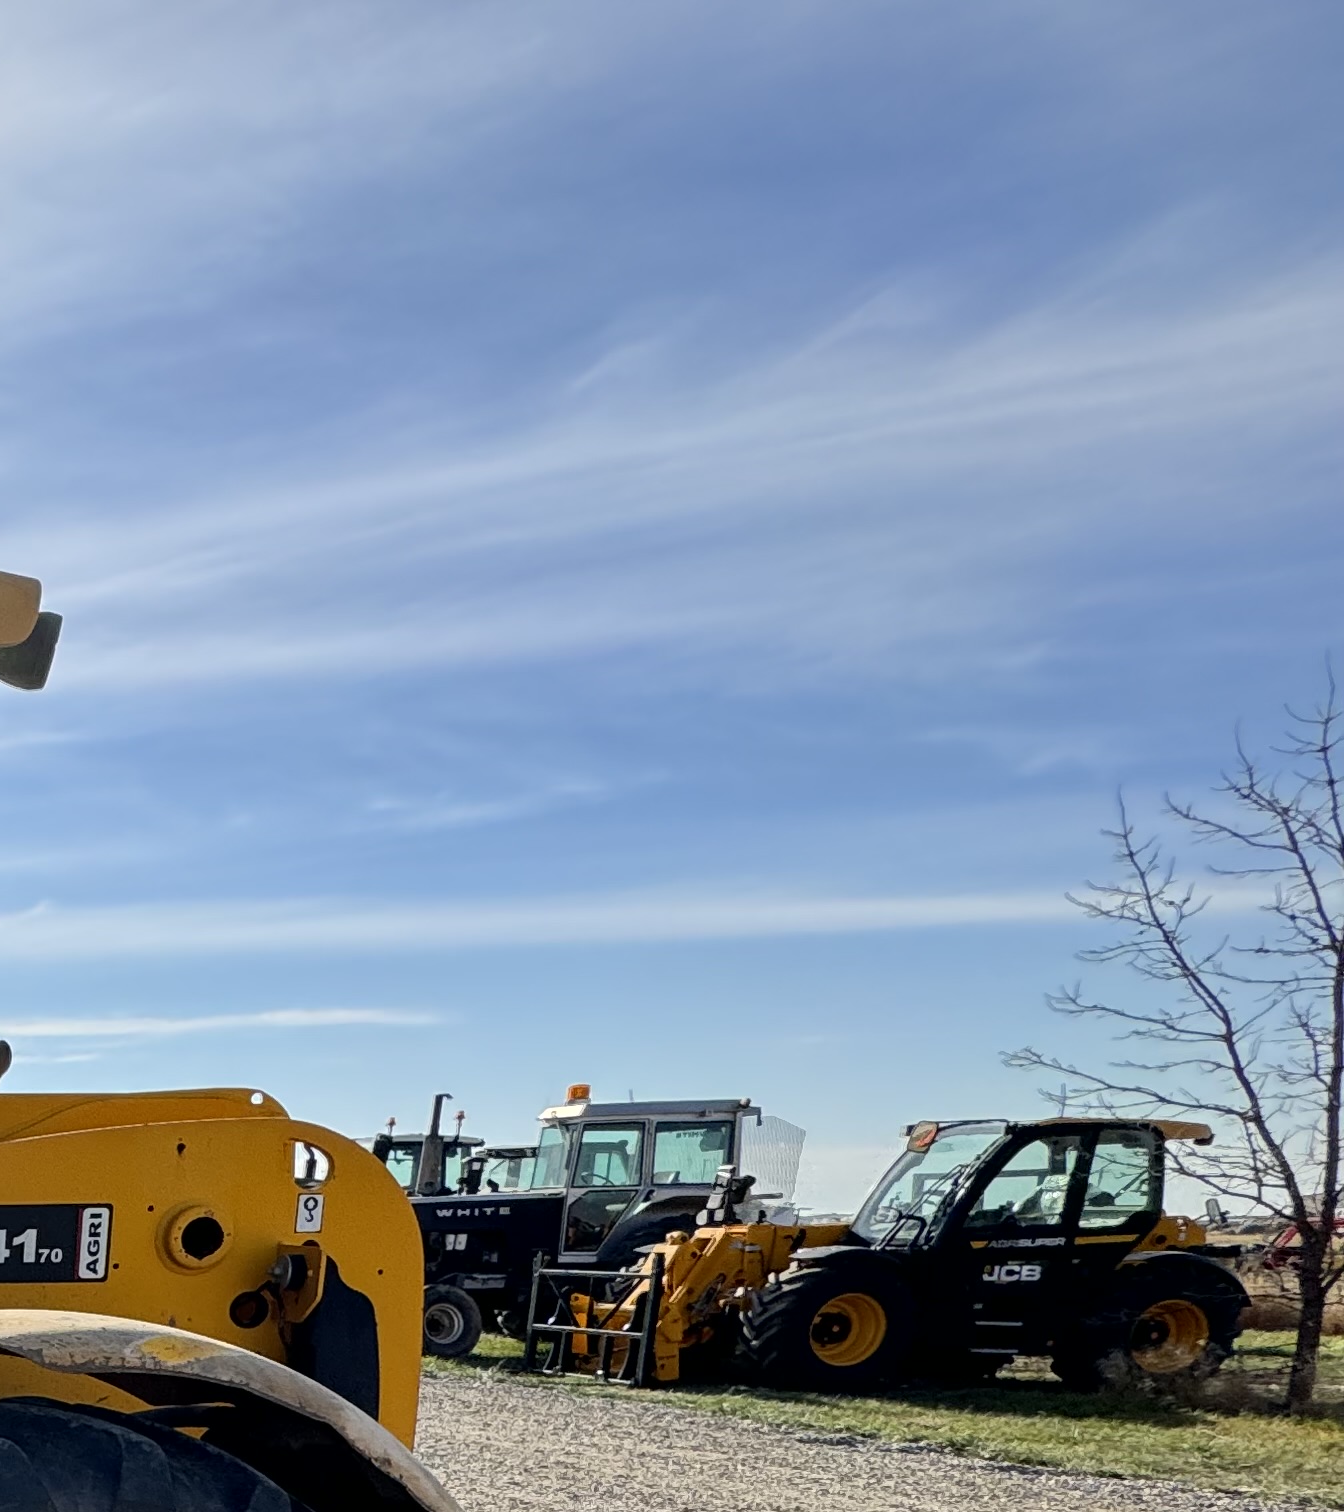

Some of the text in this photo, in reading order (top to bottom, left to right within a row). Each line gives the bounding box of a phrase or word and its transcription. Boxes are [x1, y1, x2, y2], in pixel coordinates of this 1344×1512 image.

[435, 1206, 511, 1217] WHITE
[85, 1212, 103, 1276] AGRI
[982, 1265, 1043, 1281] JCB
